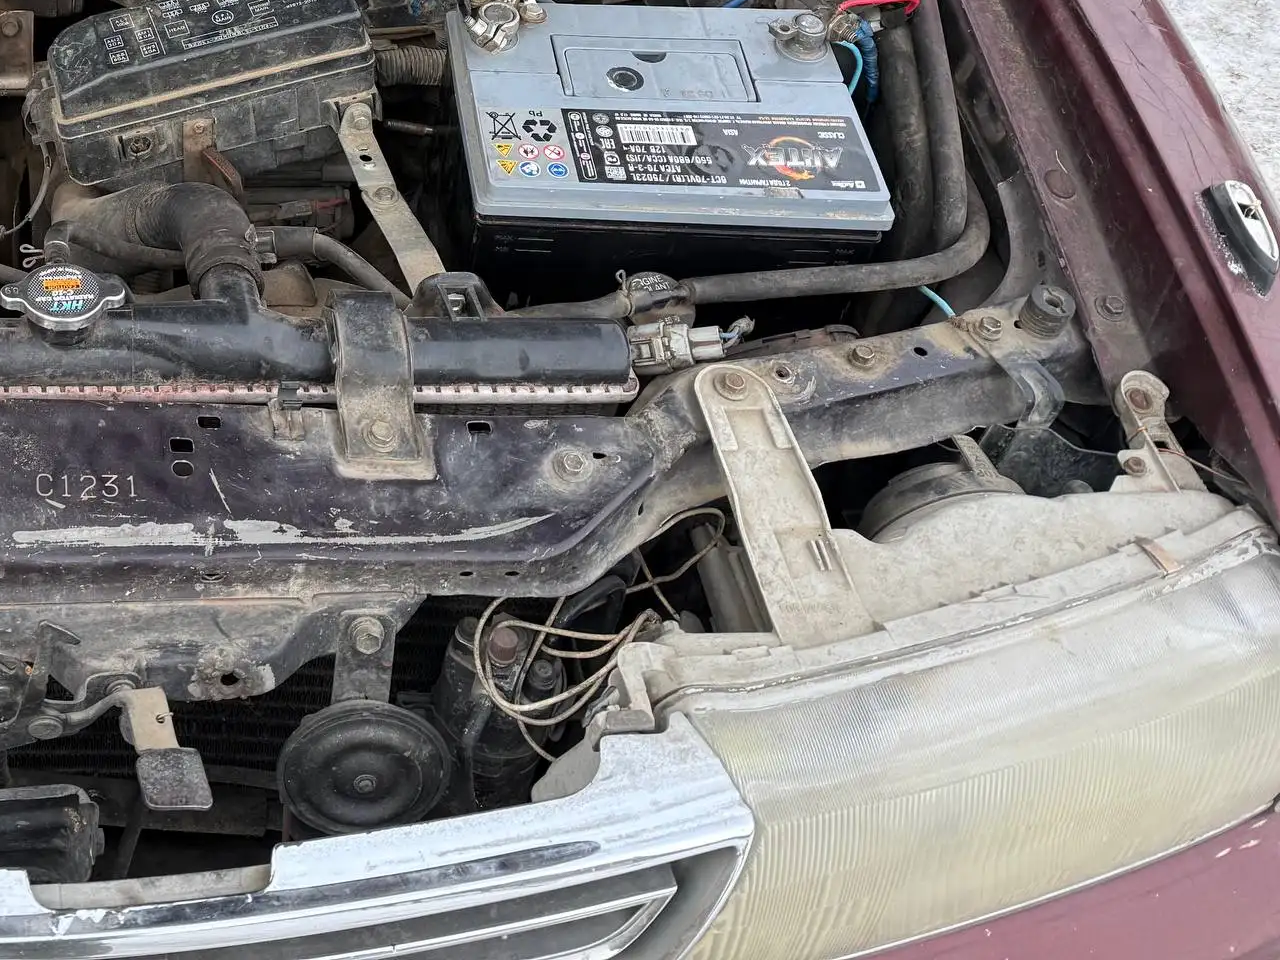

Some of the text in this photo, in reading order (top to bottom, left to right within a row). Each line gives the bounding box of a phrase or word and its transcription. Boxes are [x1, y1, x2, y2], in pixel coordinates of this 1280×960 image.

[168, 25, 186, 33] HEAD
[817, 131, 846, 139] CLASSIC
[629, 172, 665, 182] 75D23L
[50, 299, 84, 312] HKT
[36, 473, 138, 498] C1231
